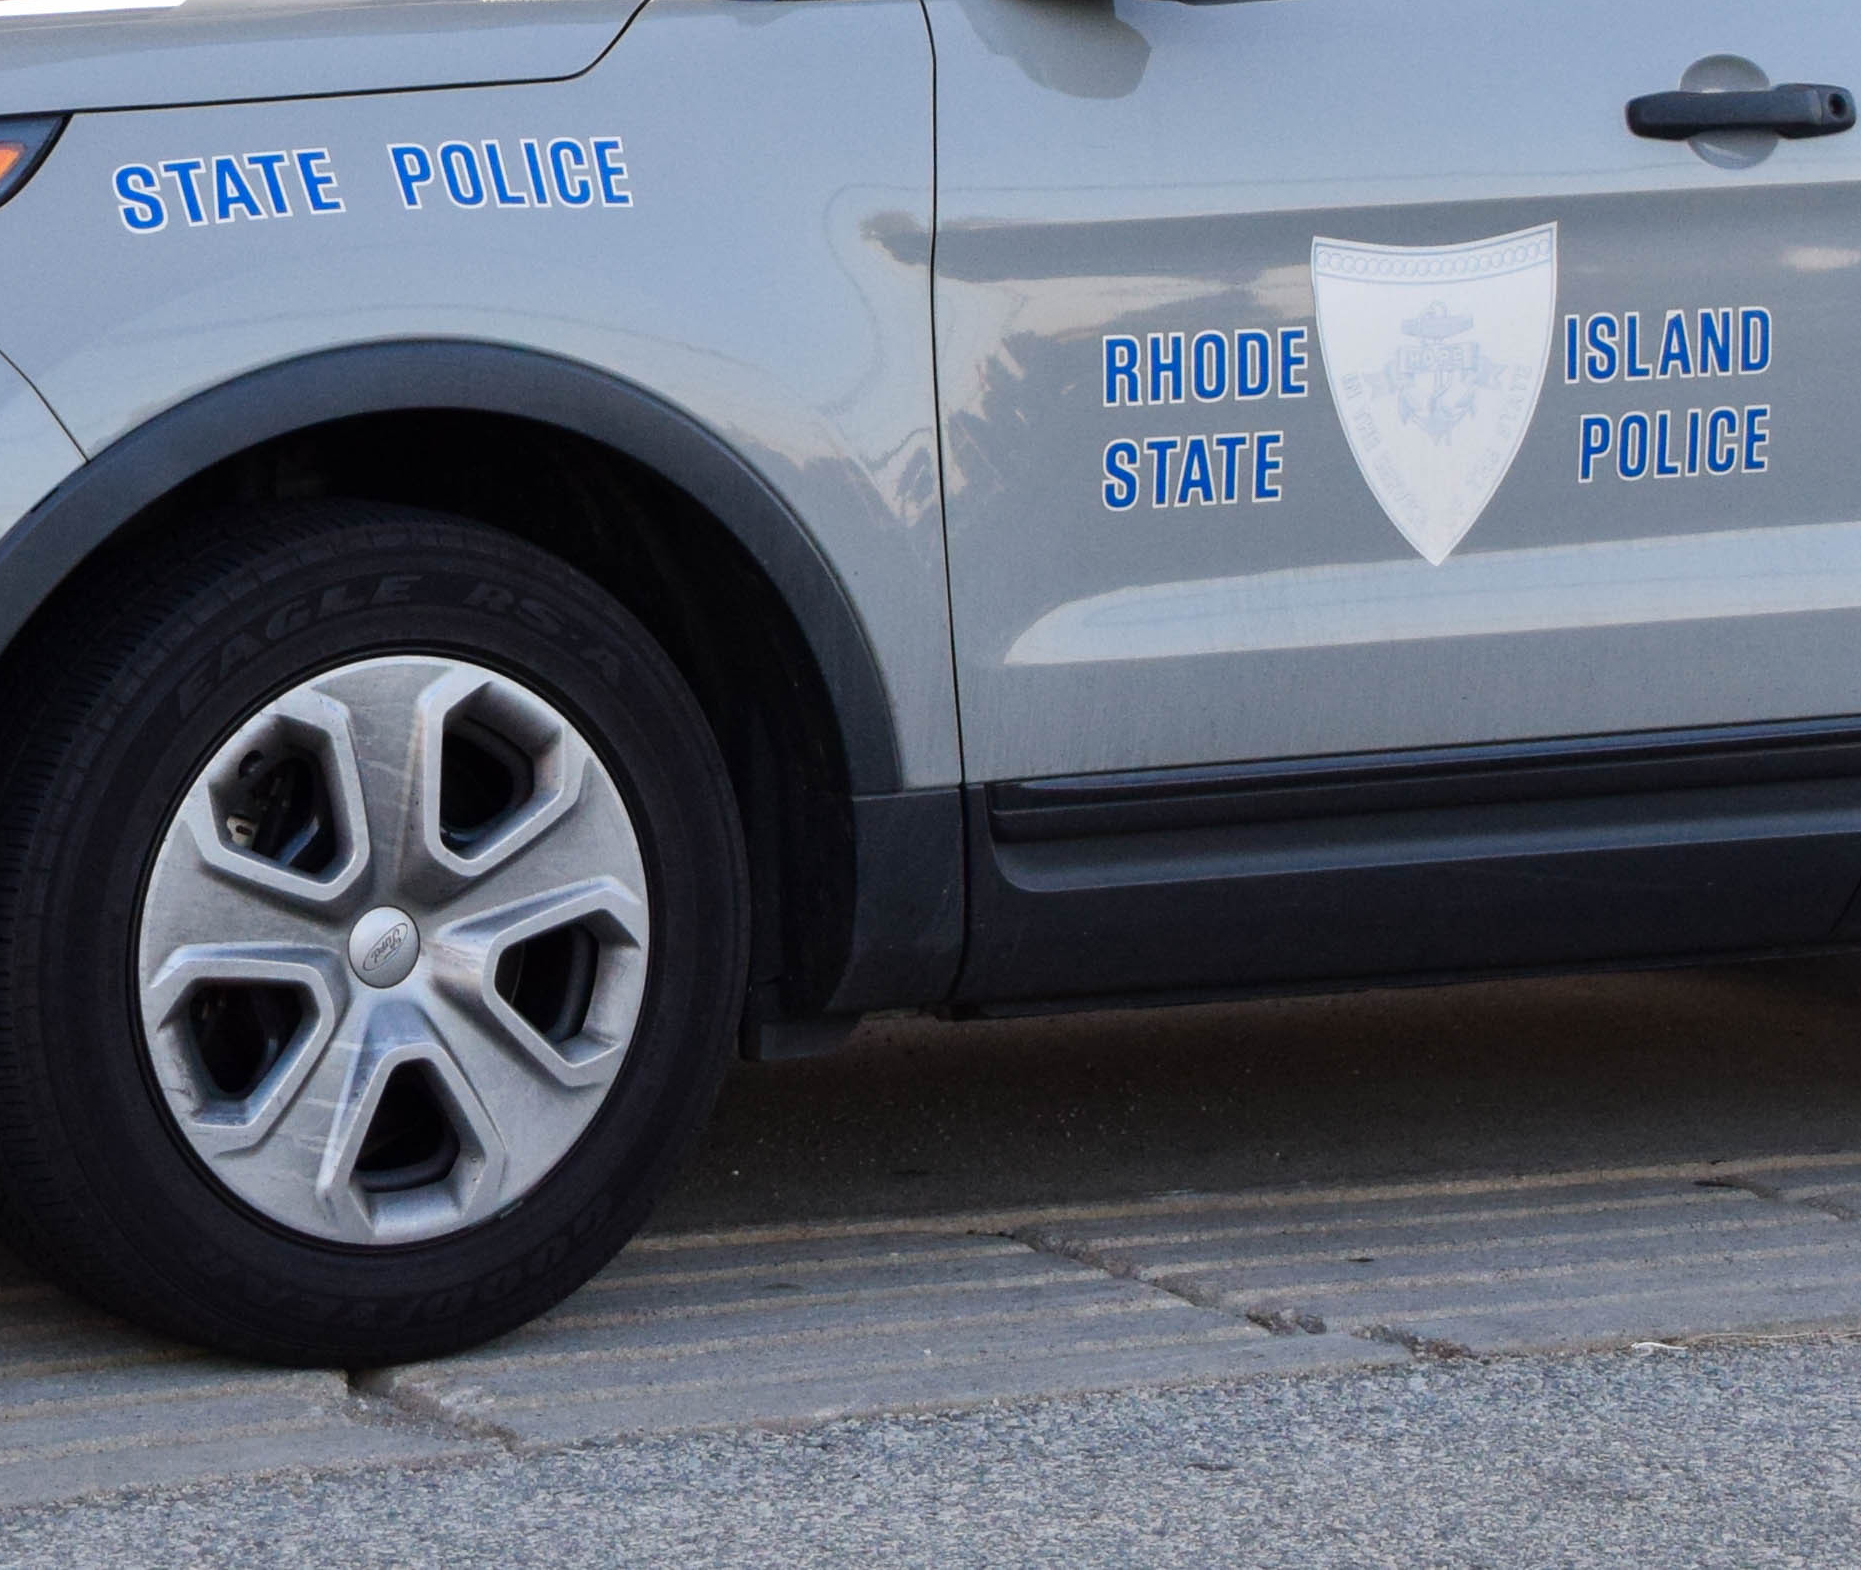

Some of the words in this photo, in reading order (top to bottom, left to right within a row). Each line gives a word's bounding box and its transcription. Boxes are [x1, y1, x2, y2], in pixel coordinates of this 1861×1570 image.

[112, 147, 345, 234] STATE
[387, 136, 634, 209] POLICE
[1102, 326, 1309, 407] RHODE
[1564, 306, 1773, 383] ISLAND
[1101, 431, 1284, 512] STATE
[1578, 405, 1771, 483] POLICE
[369, 927, 403, 966] Ford
